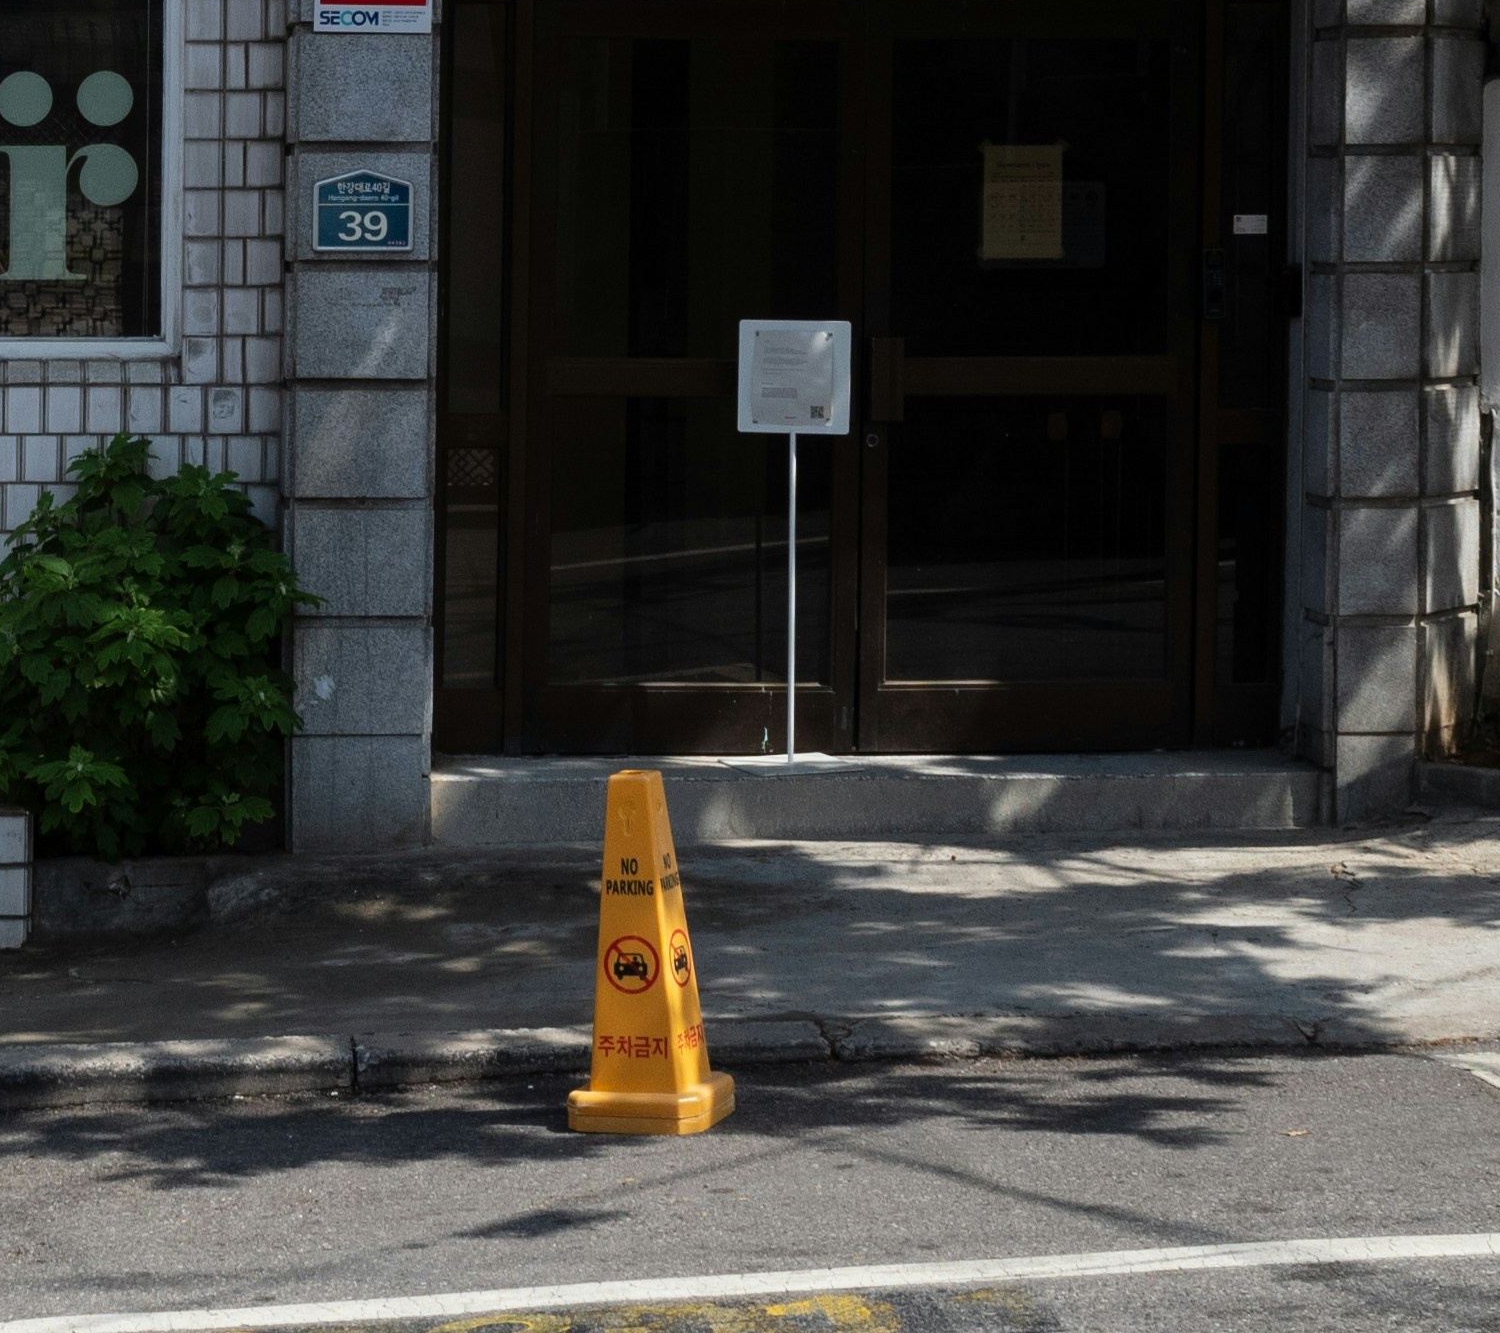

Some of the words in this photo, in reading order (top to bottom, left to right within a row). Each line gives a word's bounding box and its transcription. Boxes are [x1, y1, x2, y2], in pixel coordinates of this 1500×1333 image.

[320, 10, 379, 26] SECOM
[337, 181, 390, 194] 한강대로40길
[338, 210, 388, 242] 39
[621, 858, 638, 875] NO
[663, 853, 671, 869] NO
[606, 880, 654, 895] PARKING
[677, 1022, 704, 1054] 주차금지
[598, 1035, 668, 1059] 주차금지
